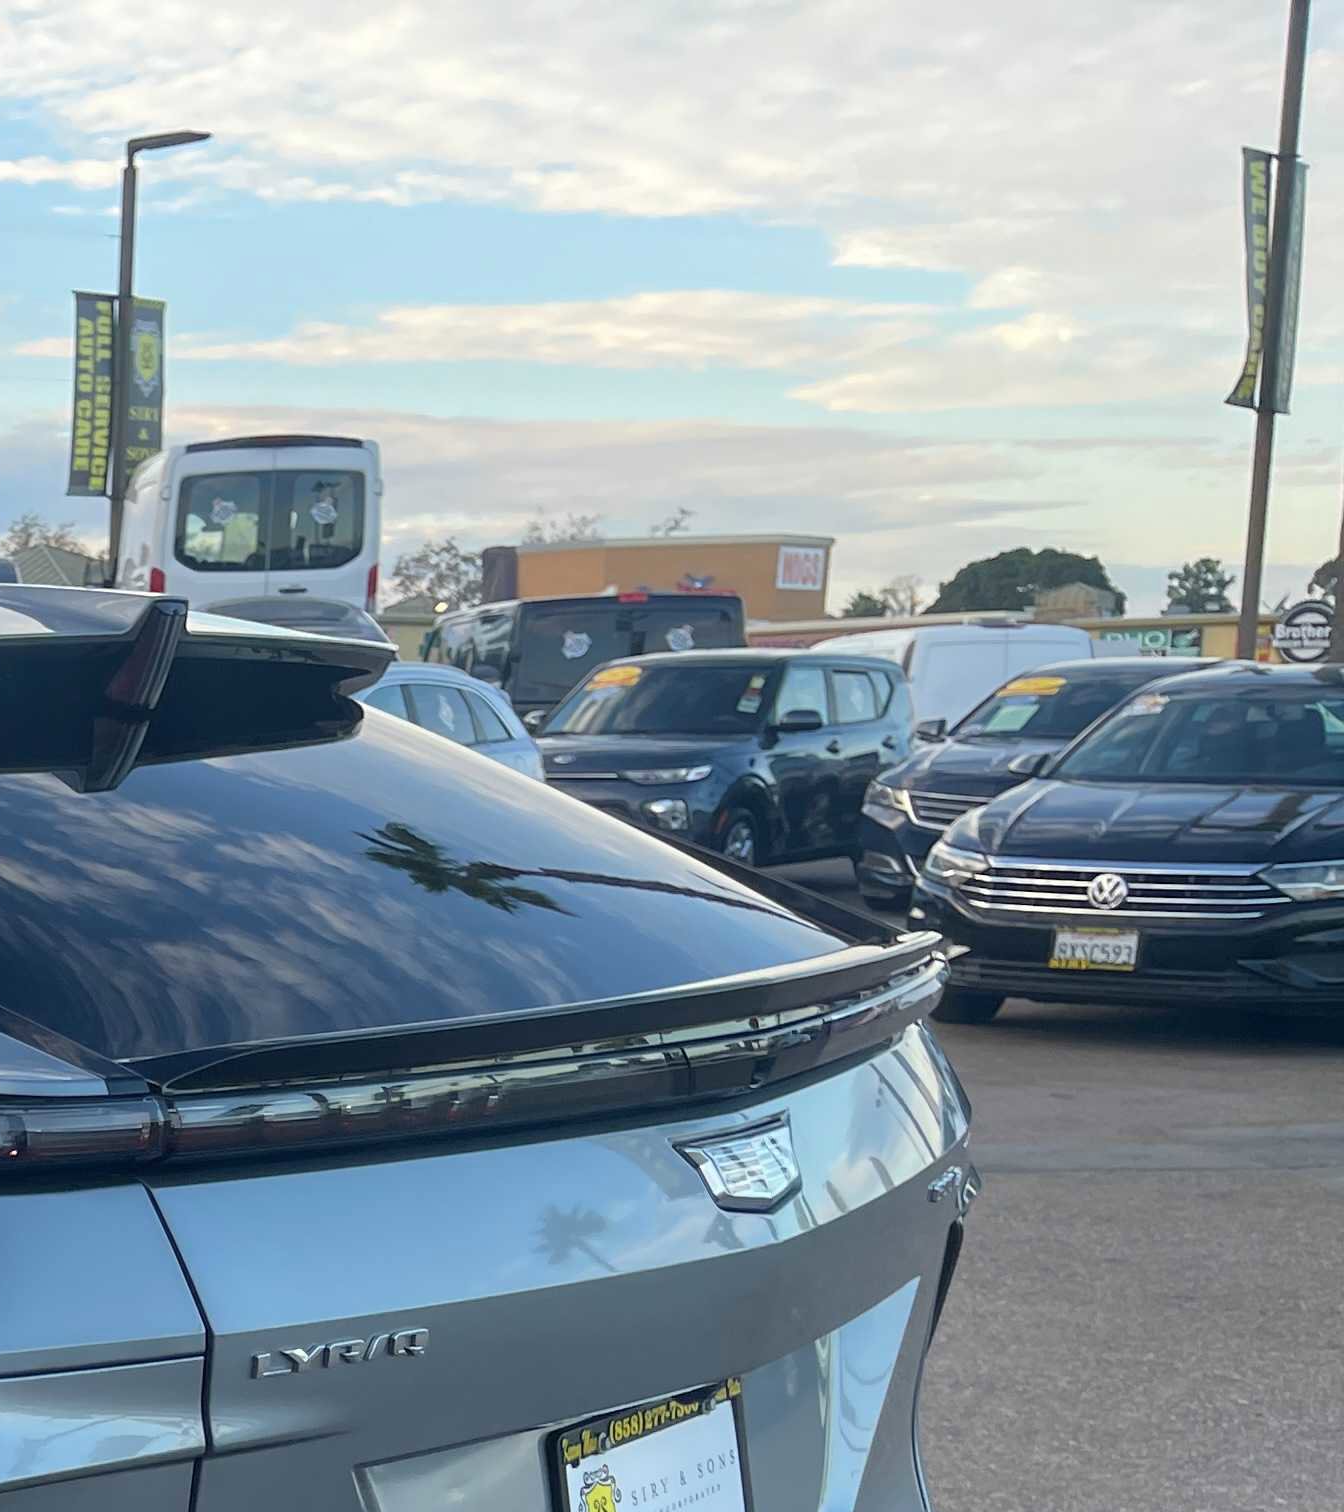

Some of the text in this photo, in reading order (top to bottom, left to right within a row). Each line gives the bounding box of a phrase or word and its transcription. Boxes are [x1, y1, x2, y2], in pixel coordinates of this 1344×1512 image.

[73, 317, 94, 471] AUTO CARE
[609, 1410, 643, 1445] (858)
[631, 1449, 736, 1506] SIRY & SONS
